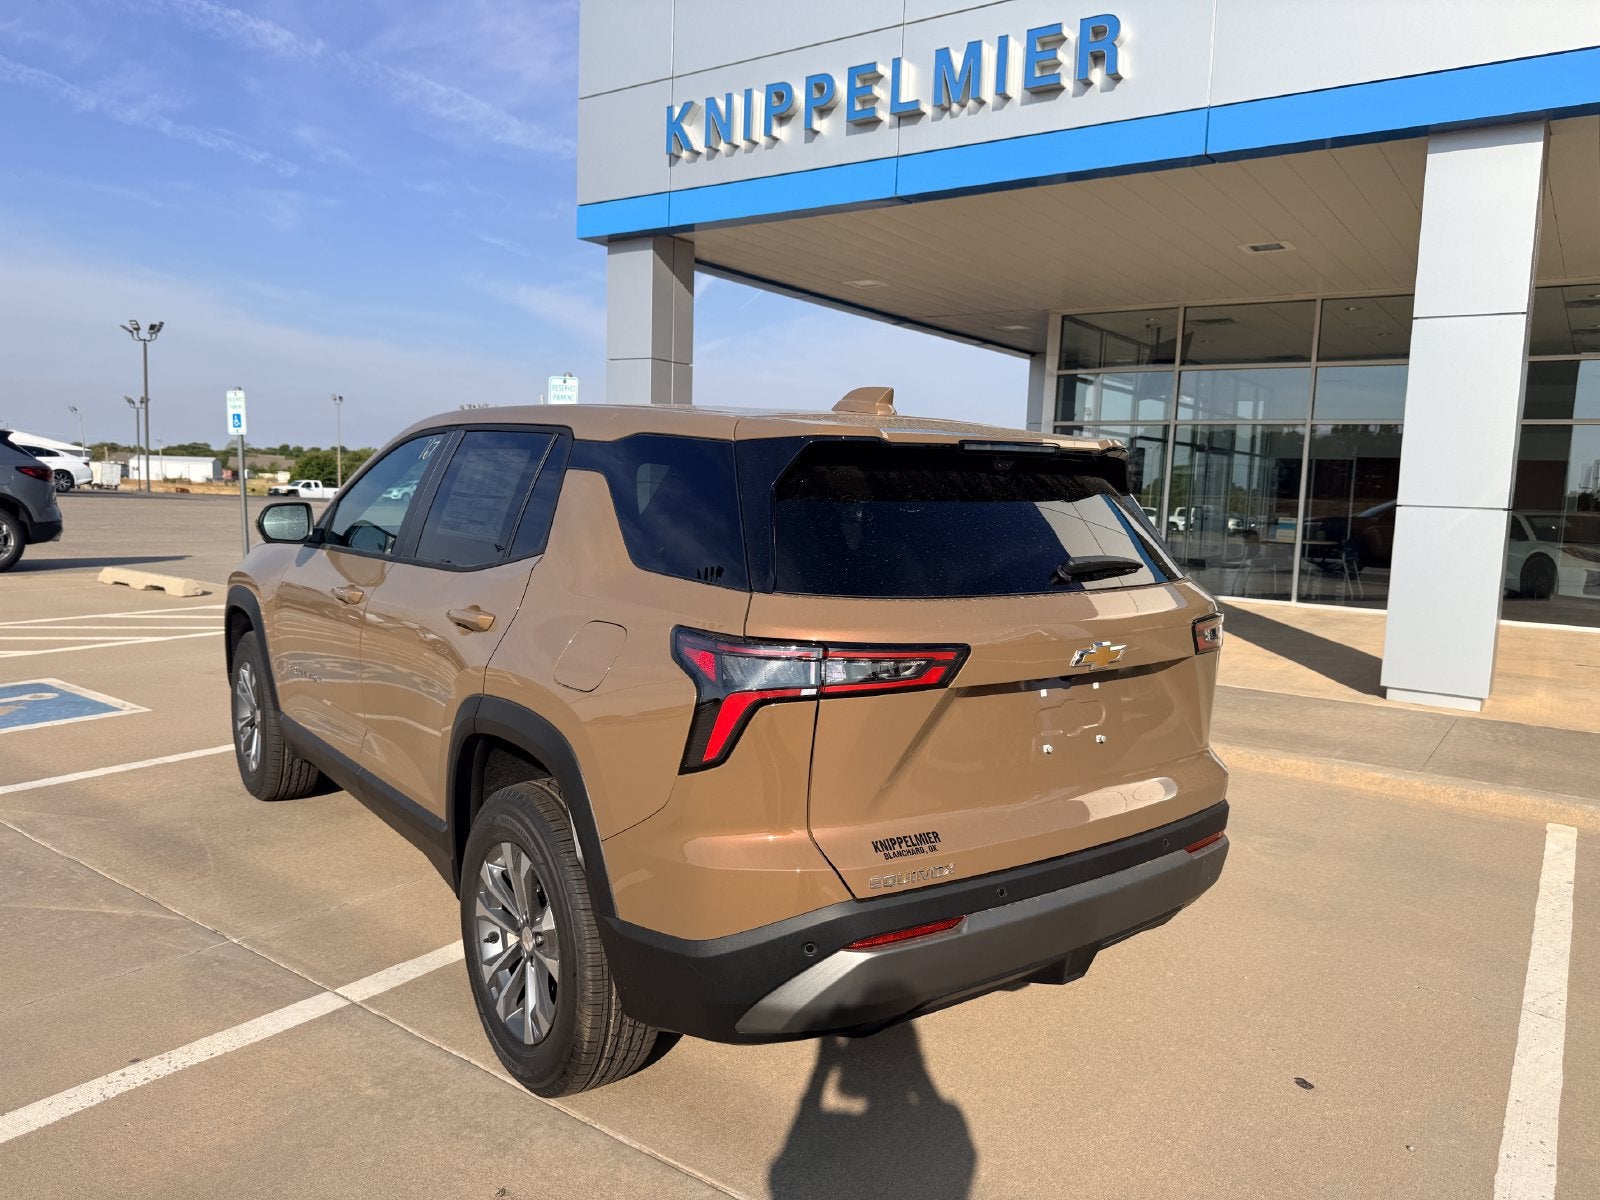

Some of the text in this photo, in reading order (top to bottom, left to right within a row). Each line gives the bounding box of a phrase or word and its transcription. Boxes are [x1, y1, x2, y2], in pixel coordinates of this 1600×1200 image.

[666, 13, 1124, 157] KNIPPELMIER
[871, 831, 941, 853] KNIPPELMIER
[929, 844, 938, 852] OK
[869, 862, 955, 889] EQUINOX
